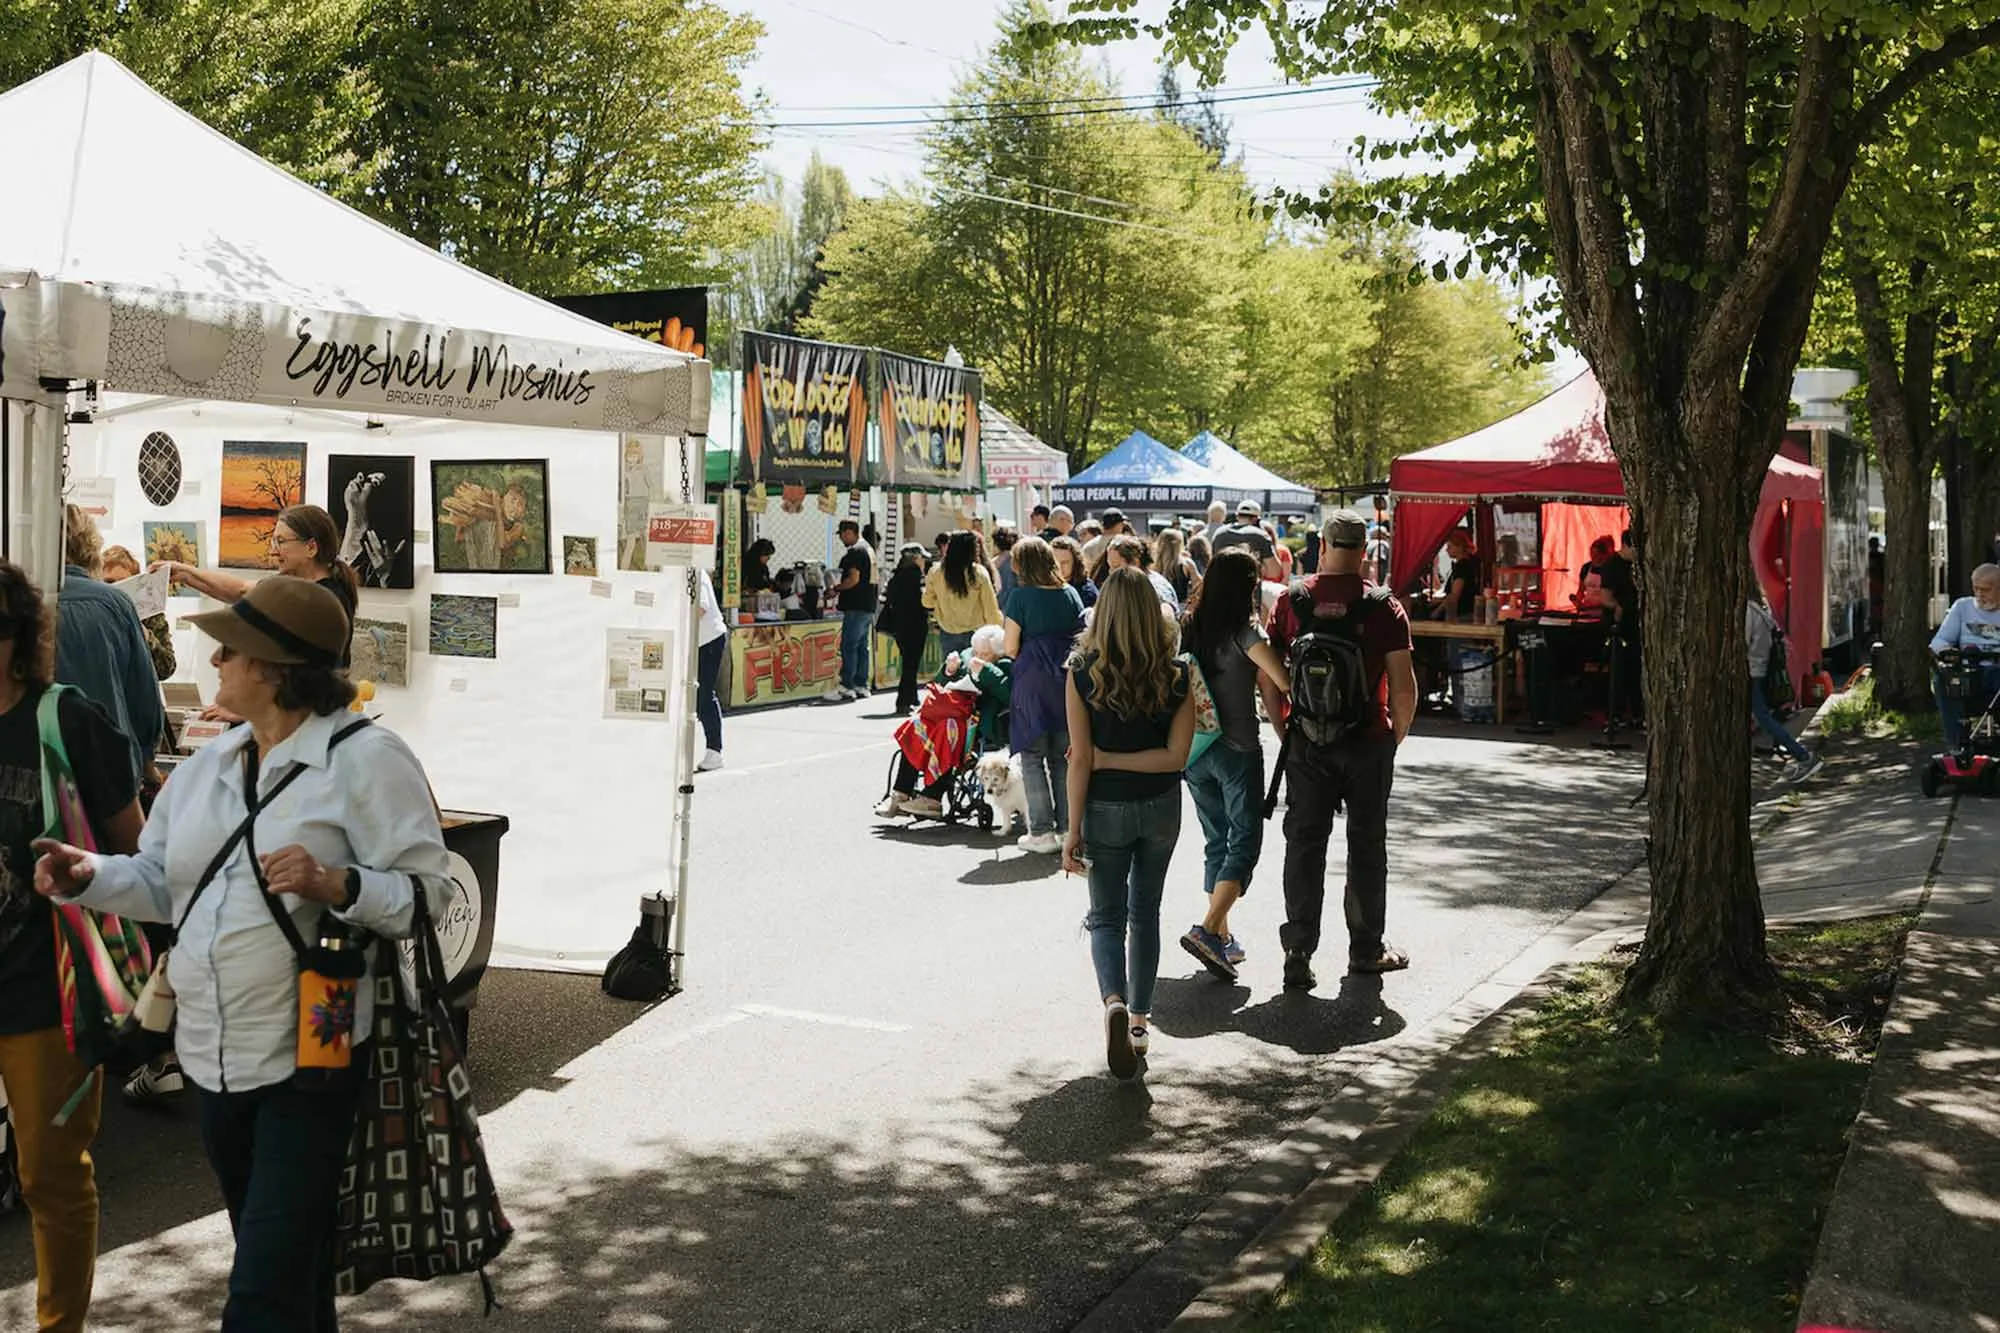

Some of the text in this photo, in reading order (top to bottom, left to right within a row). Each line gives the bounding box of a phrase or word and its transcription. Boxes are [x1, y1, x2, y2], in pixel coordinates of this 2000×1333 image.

[286, 317, 596, 405] Eggshell Mosaics
[386, 389, 499, 411] BROKEN FOR YOU ART
[987, 463, 1030, 475] loats
[1066, 487, 1085, 502] FOR
[1087, 487, 1126, 503] PEOPLE,
[1128, 488, 1149, 501] NOT
[1150, 488, 1170, 501] FOR
[1171, 488, 1208, 501] PROFIT
